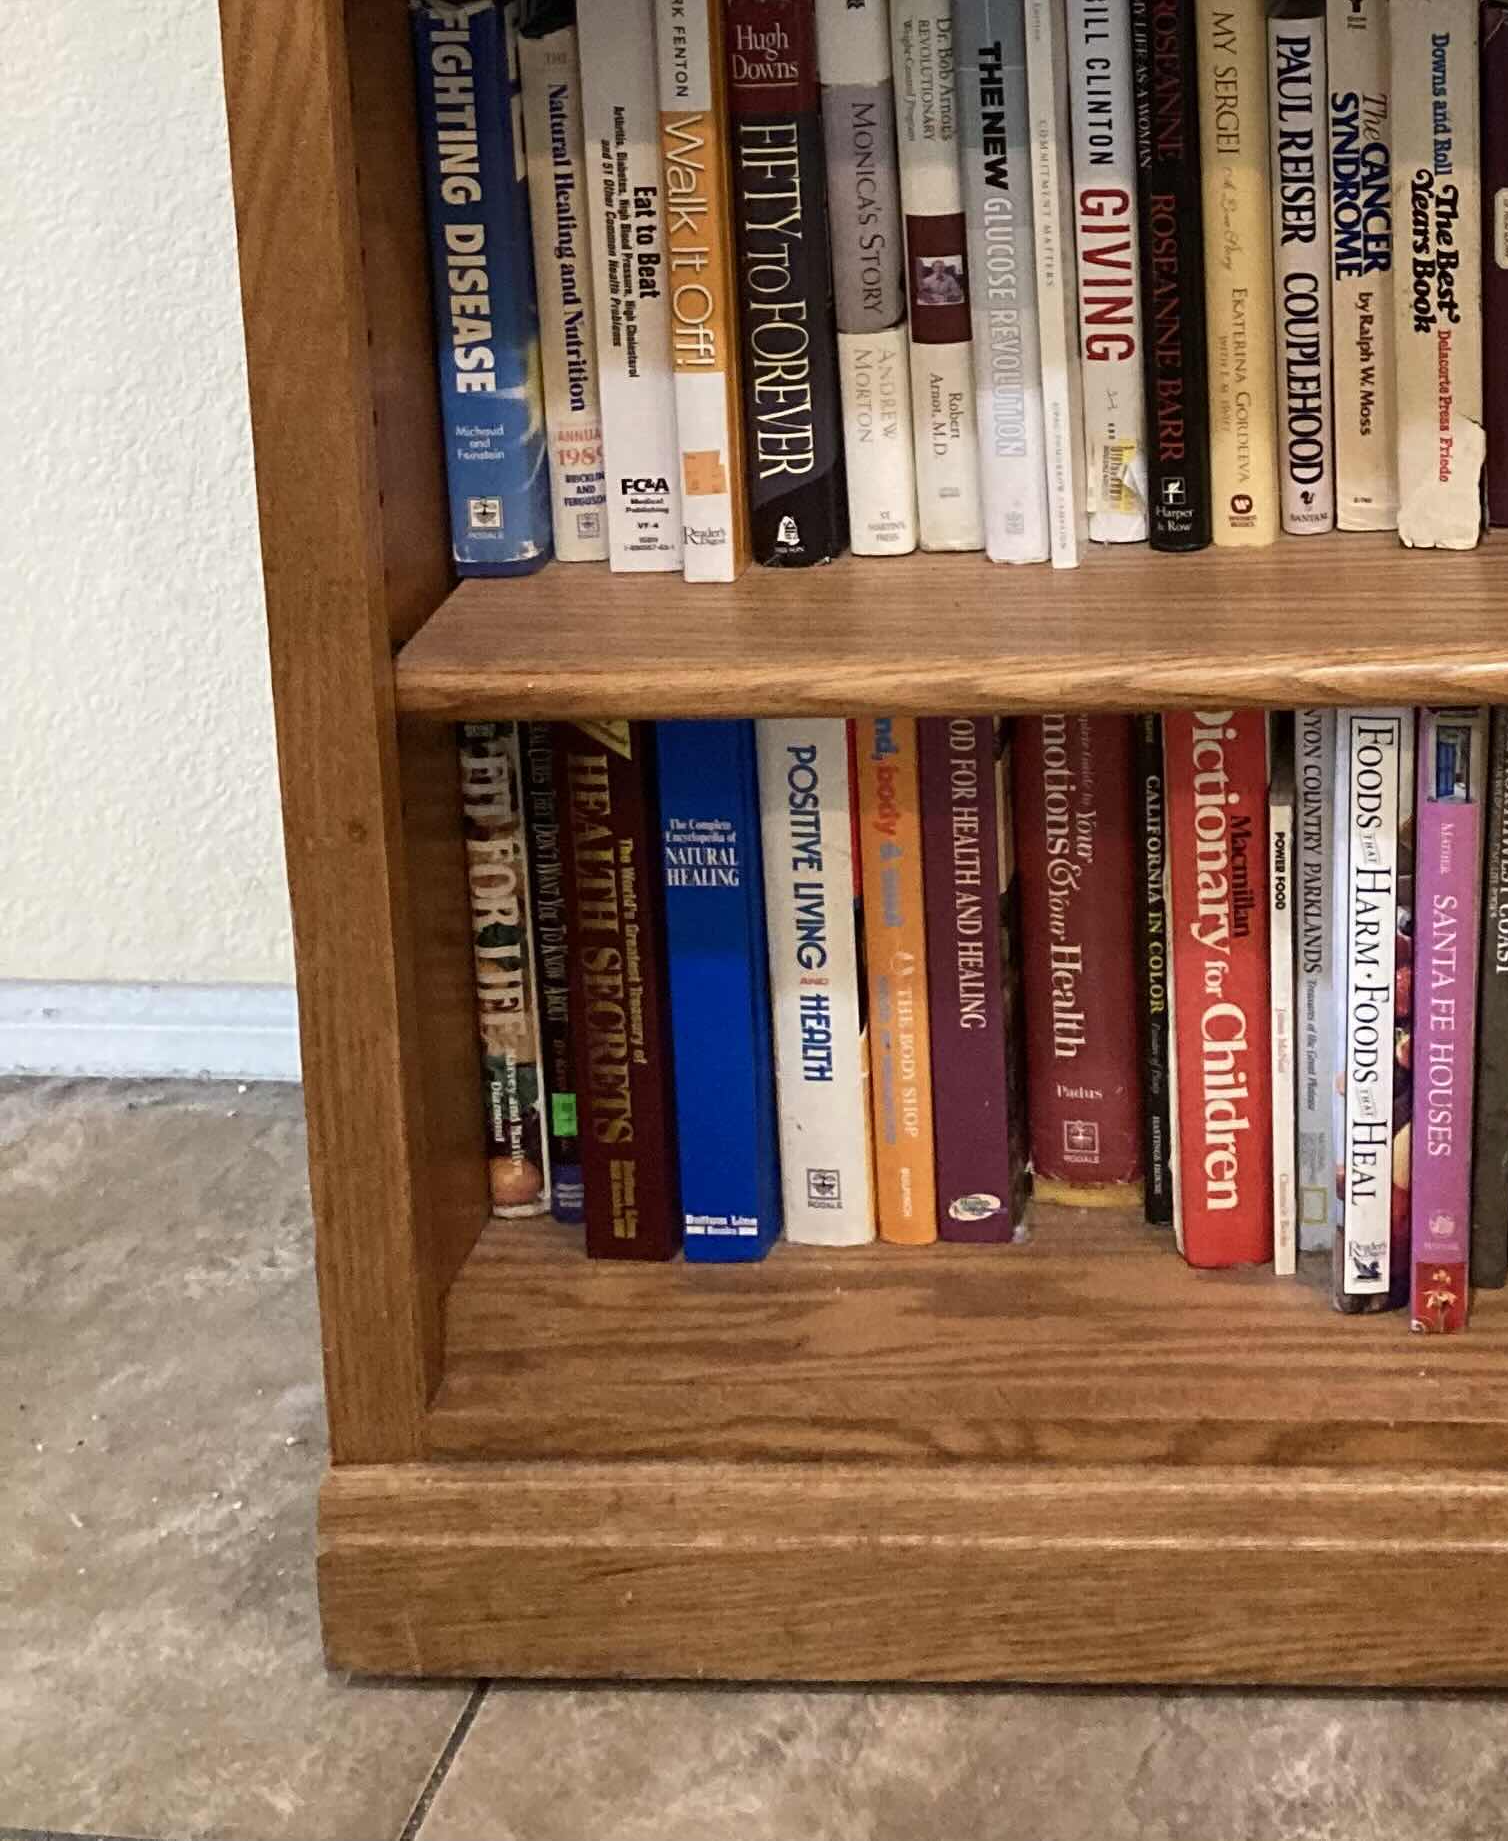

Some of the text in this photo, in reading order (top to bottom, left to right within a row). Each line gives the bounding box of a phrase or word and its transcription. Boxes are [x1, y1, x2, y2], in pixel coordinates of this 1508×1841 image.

[732, 55, 799, 79] Downs
[737, 23, 790, 57] Hugh
[1086, 57, 1114, 167] CLINTON
[1331, 91, 1362, 281] SYNDROME
[1360, 93, 1391, 275] The CANCER
[634, 185, 661, 300] Eat to Beat
[662, 115, 716, 369] Walk It Off!
[1080, 187, 1136, 364] GIVING
[1275, 35, 1324, 485] PAUL REISER COUPLEHOOD
[444, 223, 495, 394] DISEASE
[740, 121, 815, 479] FIFTY TO FOREVER
[1357, 291, 1374, 312] by
[1358, 314, 1374, 362] Ralph
[1360, 391, 1372, 437] Moss
[620, 477, 670, 495] FC&A
[786, 745, 824, 873] POSITIVE
[1355, 725, 1393, 830] FOODS
[665, 848, 738, 866] NATURAL
[667, 868, 739, 888] HEALING
[1230, 813, 1255, 938] Macmillan
[1274, 833, 1286, 910] POWER FOOD
[793, 882, 827, 970] LIVING
[1353, 865, 1392, 966] HARM
[799, 994, 833, 1082] HEALTH
[1351, 983, 1391, 1085] FOODS
[1425, 893, 1458, 1157] SANTA FE HOUSES
[1056, 1085, 1103, 1100] Padus
[1201, 960, 1250, 1211] for Children
[1350, 1120, 1388, 1206] HEAL
